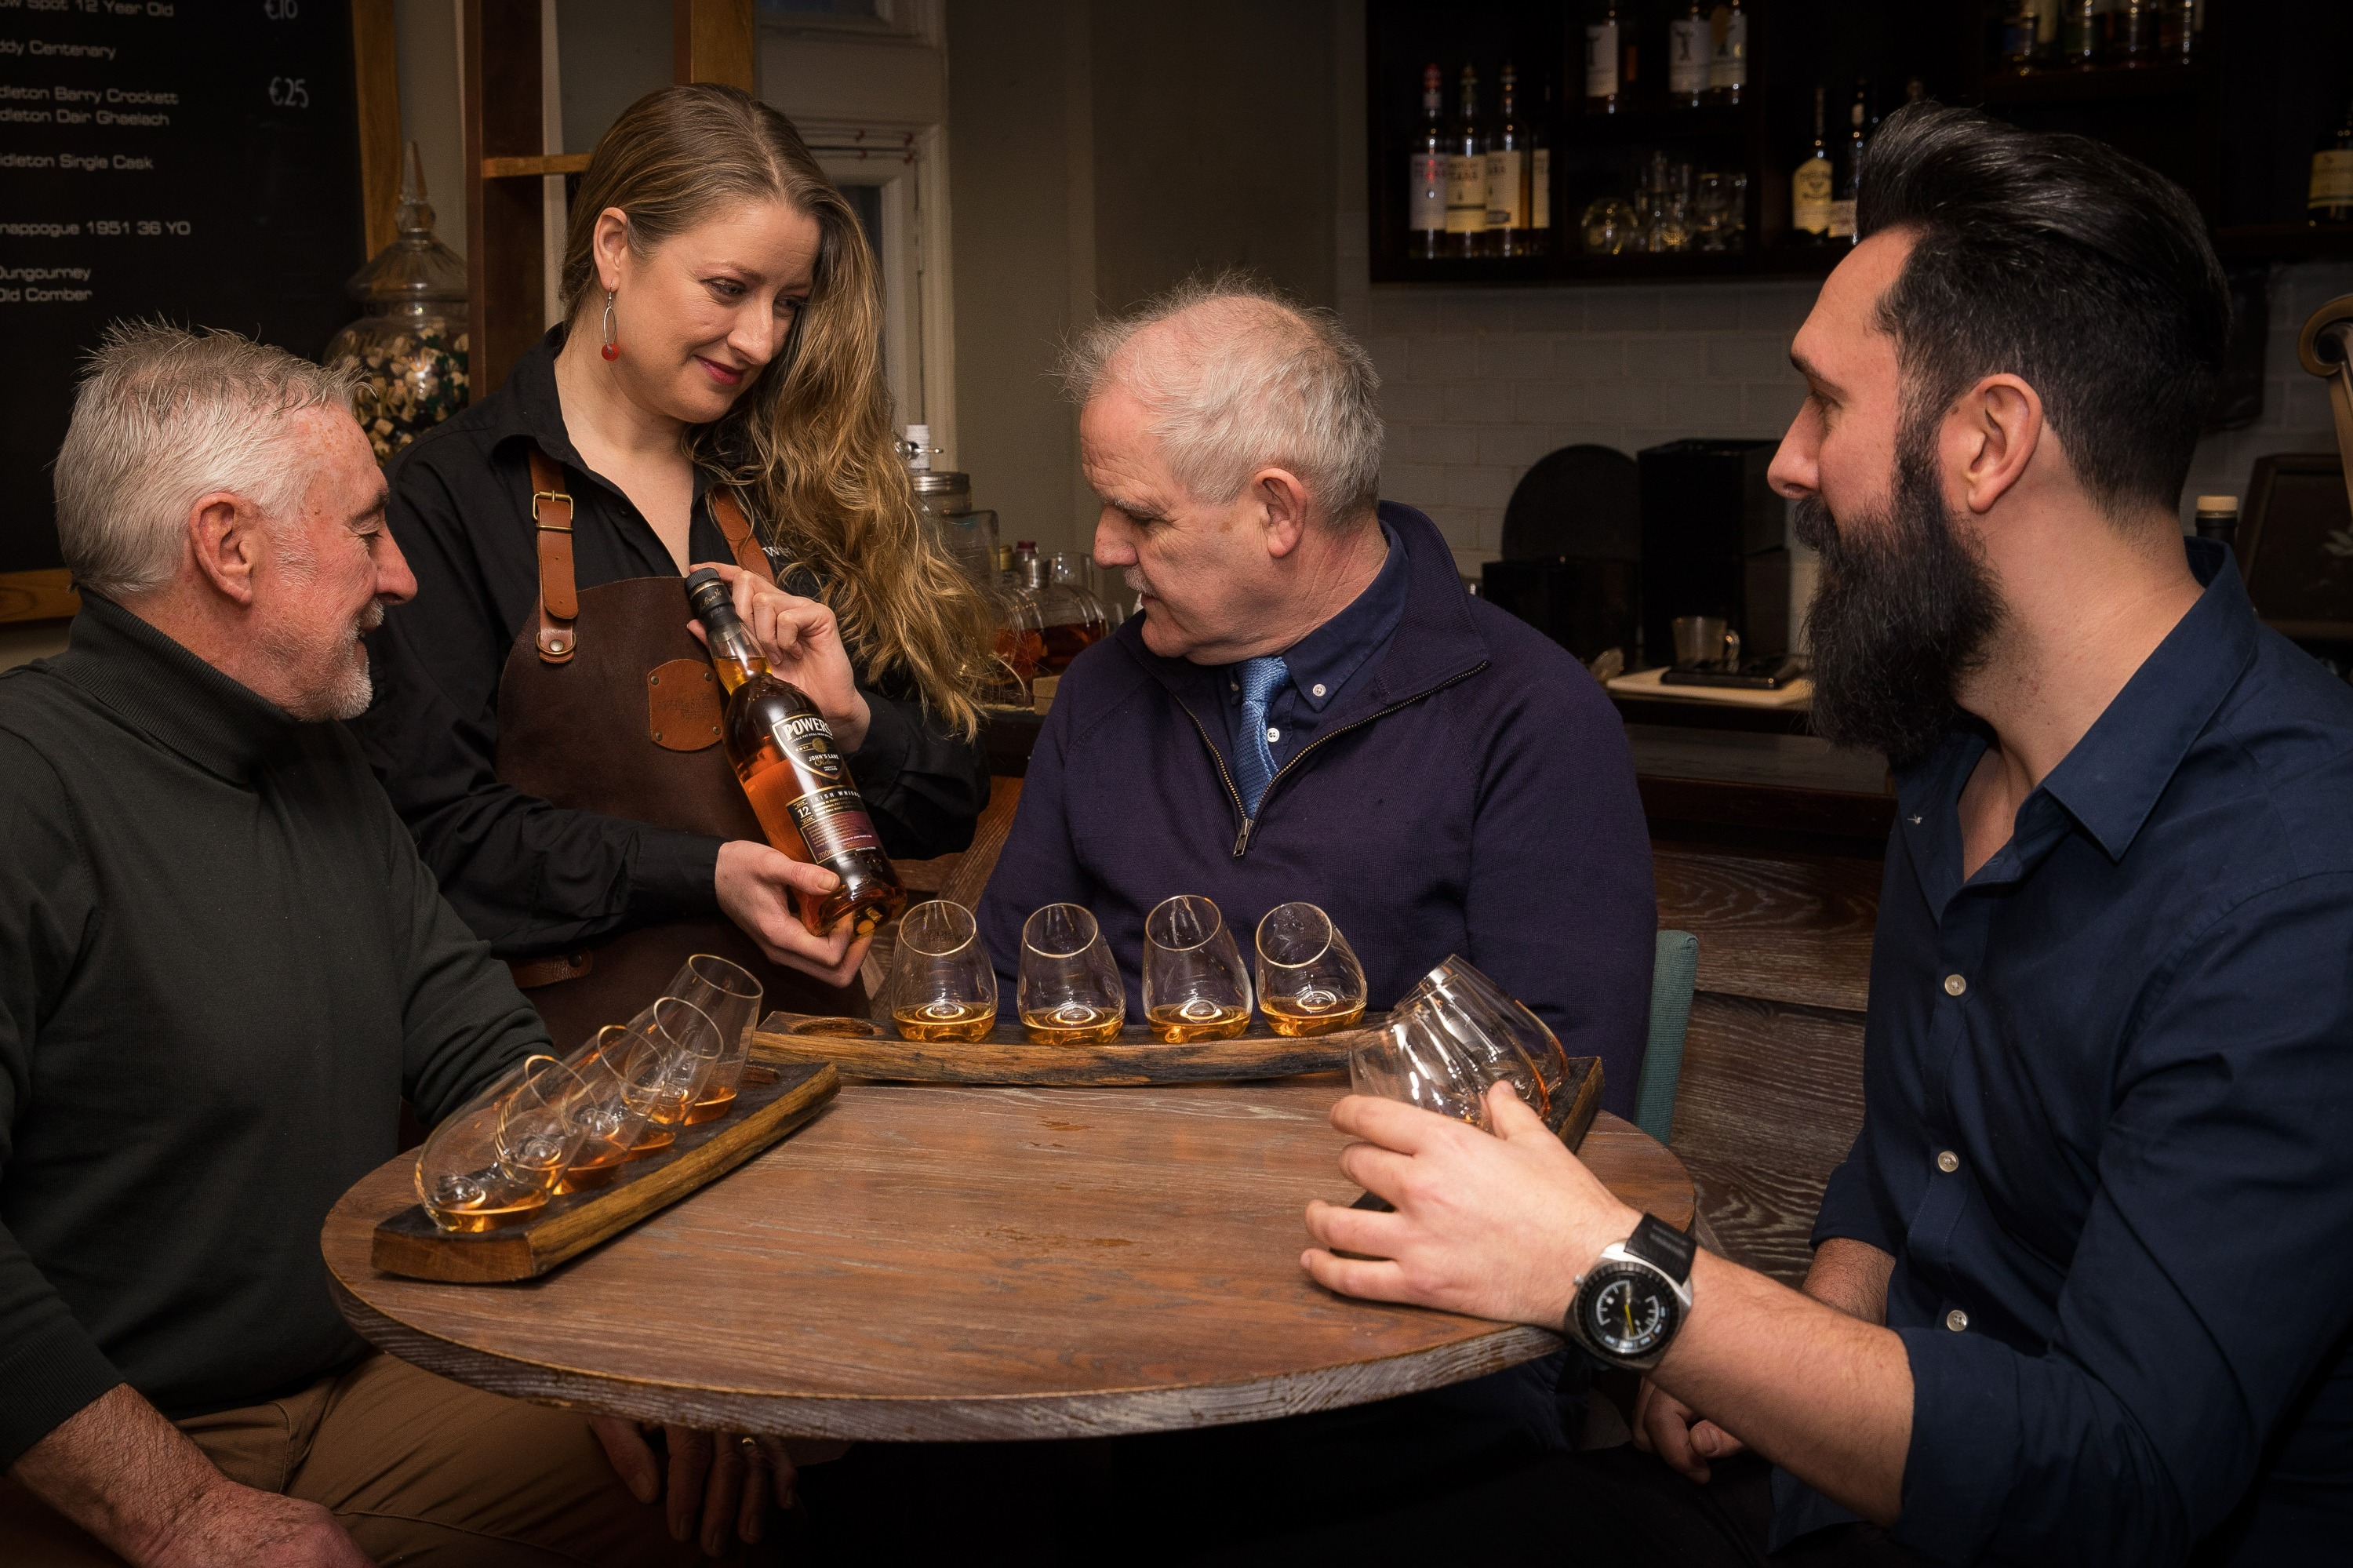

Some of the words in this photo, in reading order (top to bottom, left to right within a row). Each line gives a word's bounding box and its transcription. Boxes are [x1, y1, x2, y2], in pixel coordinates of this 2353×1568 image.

[27, 0, 69, 12] Spot
[75, 0, 99, 13] 12
[102, 0, 143, 15] Year
[147, 2, 174, 17] Old
[28, 39, 117, 61] Centenary
[54, 85, 103, 105] Barry
[106, 88, 180, 105] Crockett
[268, 76, 310, 108] €25
[56, 109, 93, 124] Dair
[96, 110, 170, 126] Ghaelach
[59, 153, 110, 172] Single
[112, 155, 155, 170] Cask
[164, 220, 191, 235] YO
[25, 286, 93, 302] Comber
[783, 718, 833, 740] POWERS
[811, 792, 834, 802] IRISH
[798, 806, 811, 818] 12
